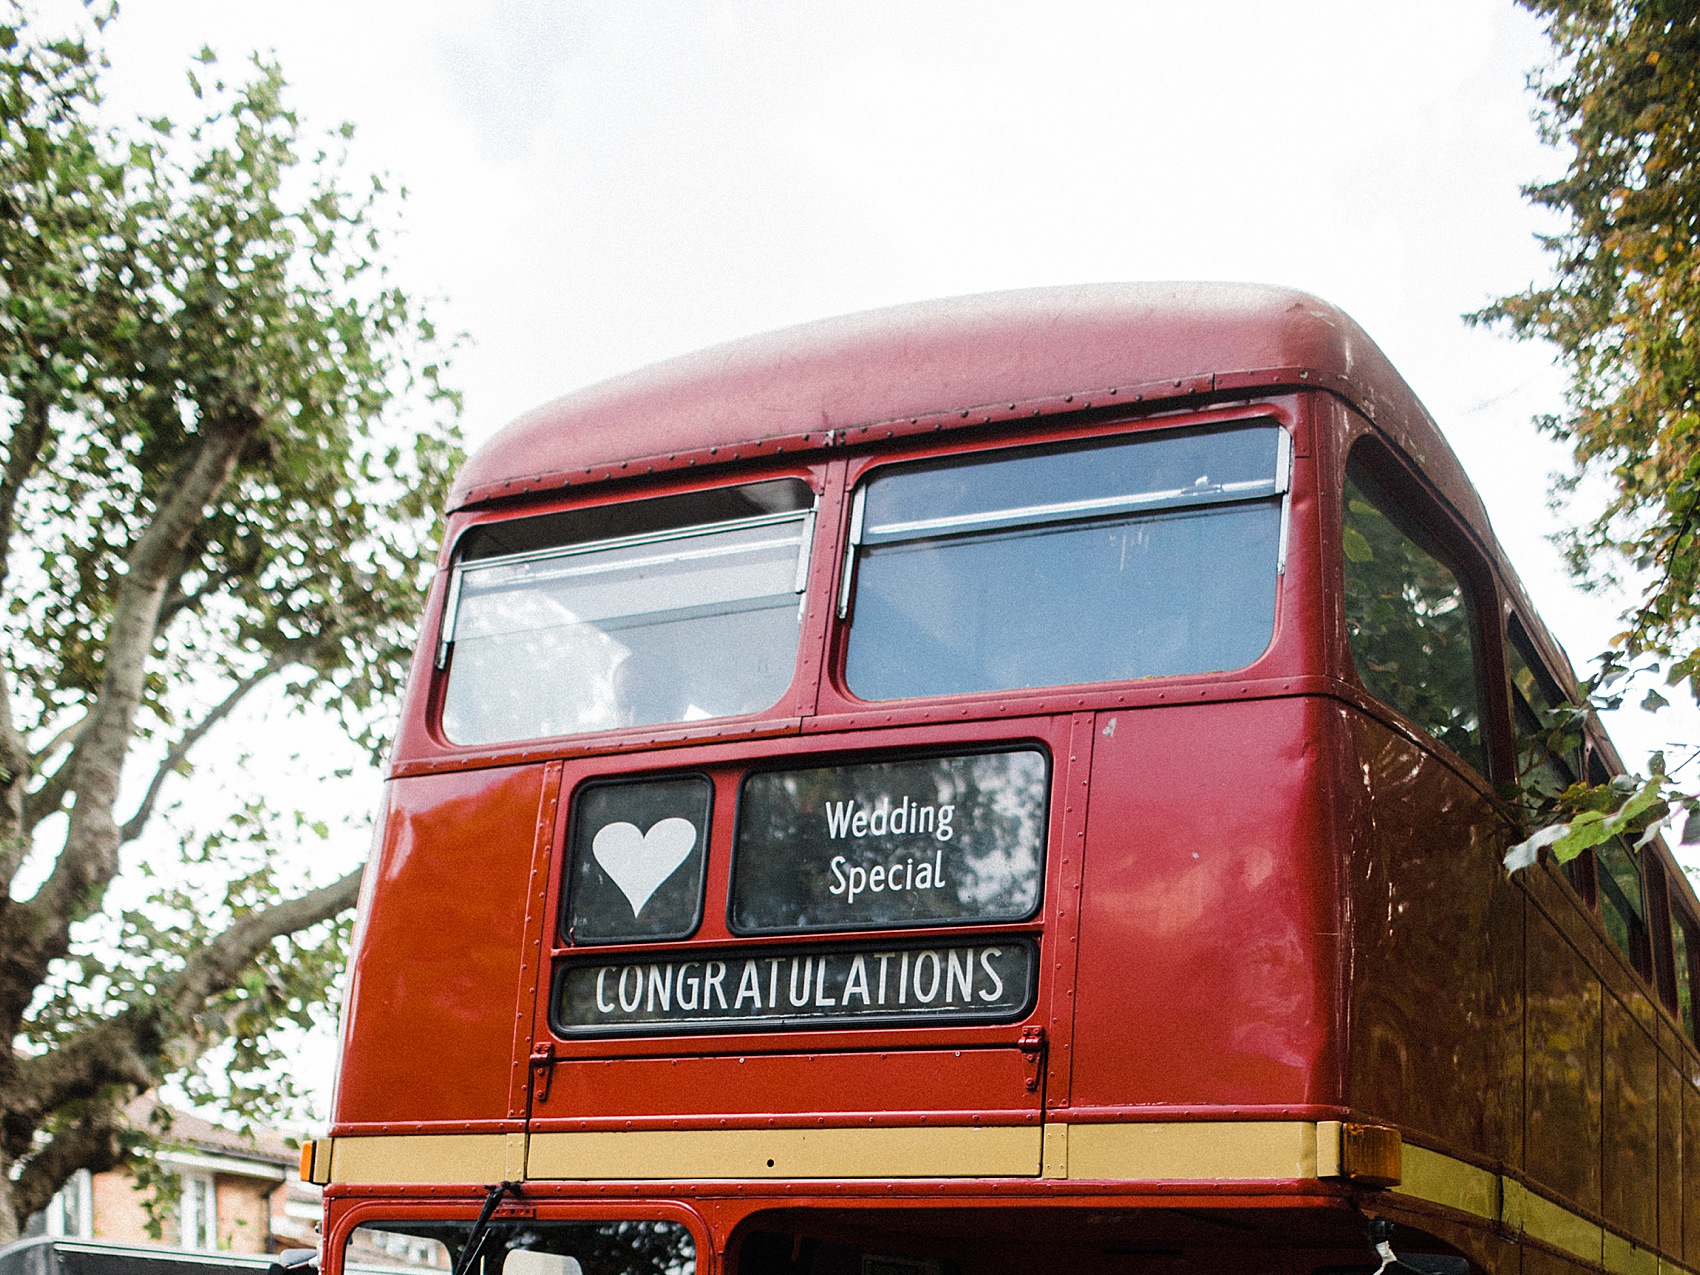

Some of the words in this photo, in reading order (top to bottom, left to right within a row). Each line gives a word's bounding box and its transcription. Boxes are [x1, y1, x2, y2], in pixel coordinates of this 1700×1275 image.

[825, 797, 955, 841] Wedding
[829, 850, 945, 903] Special
[596, 947, 1004, 1013] CONGRATULATIONS
